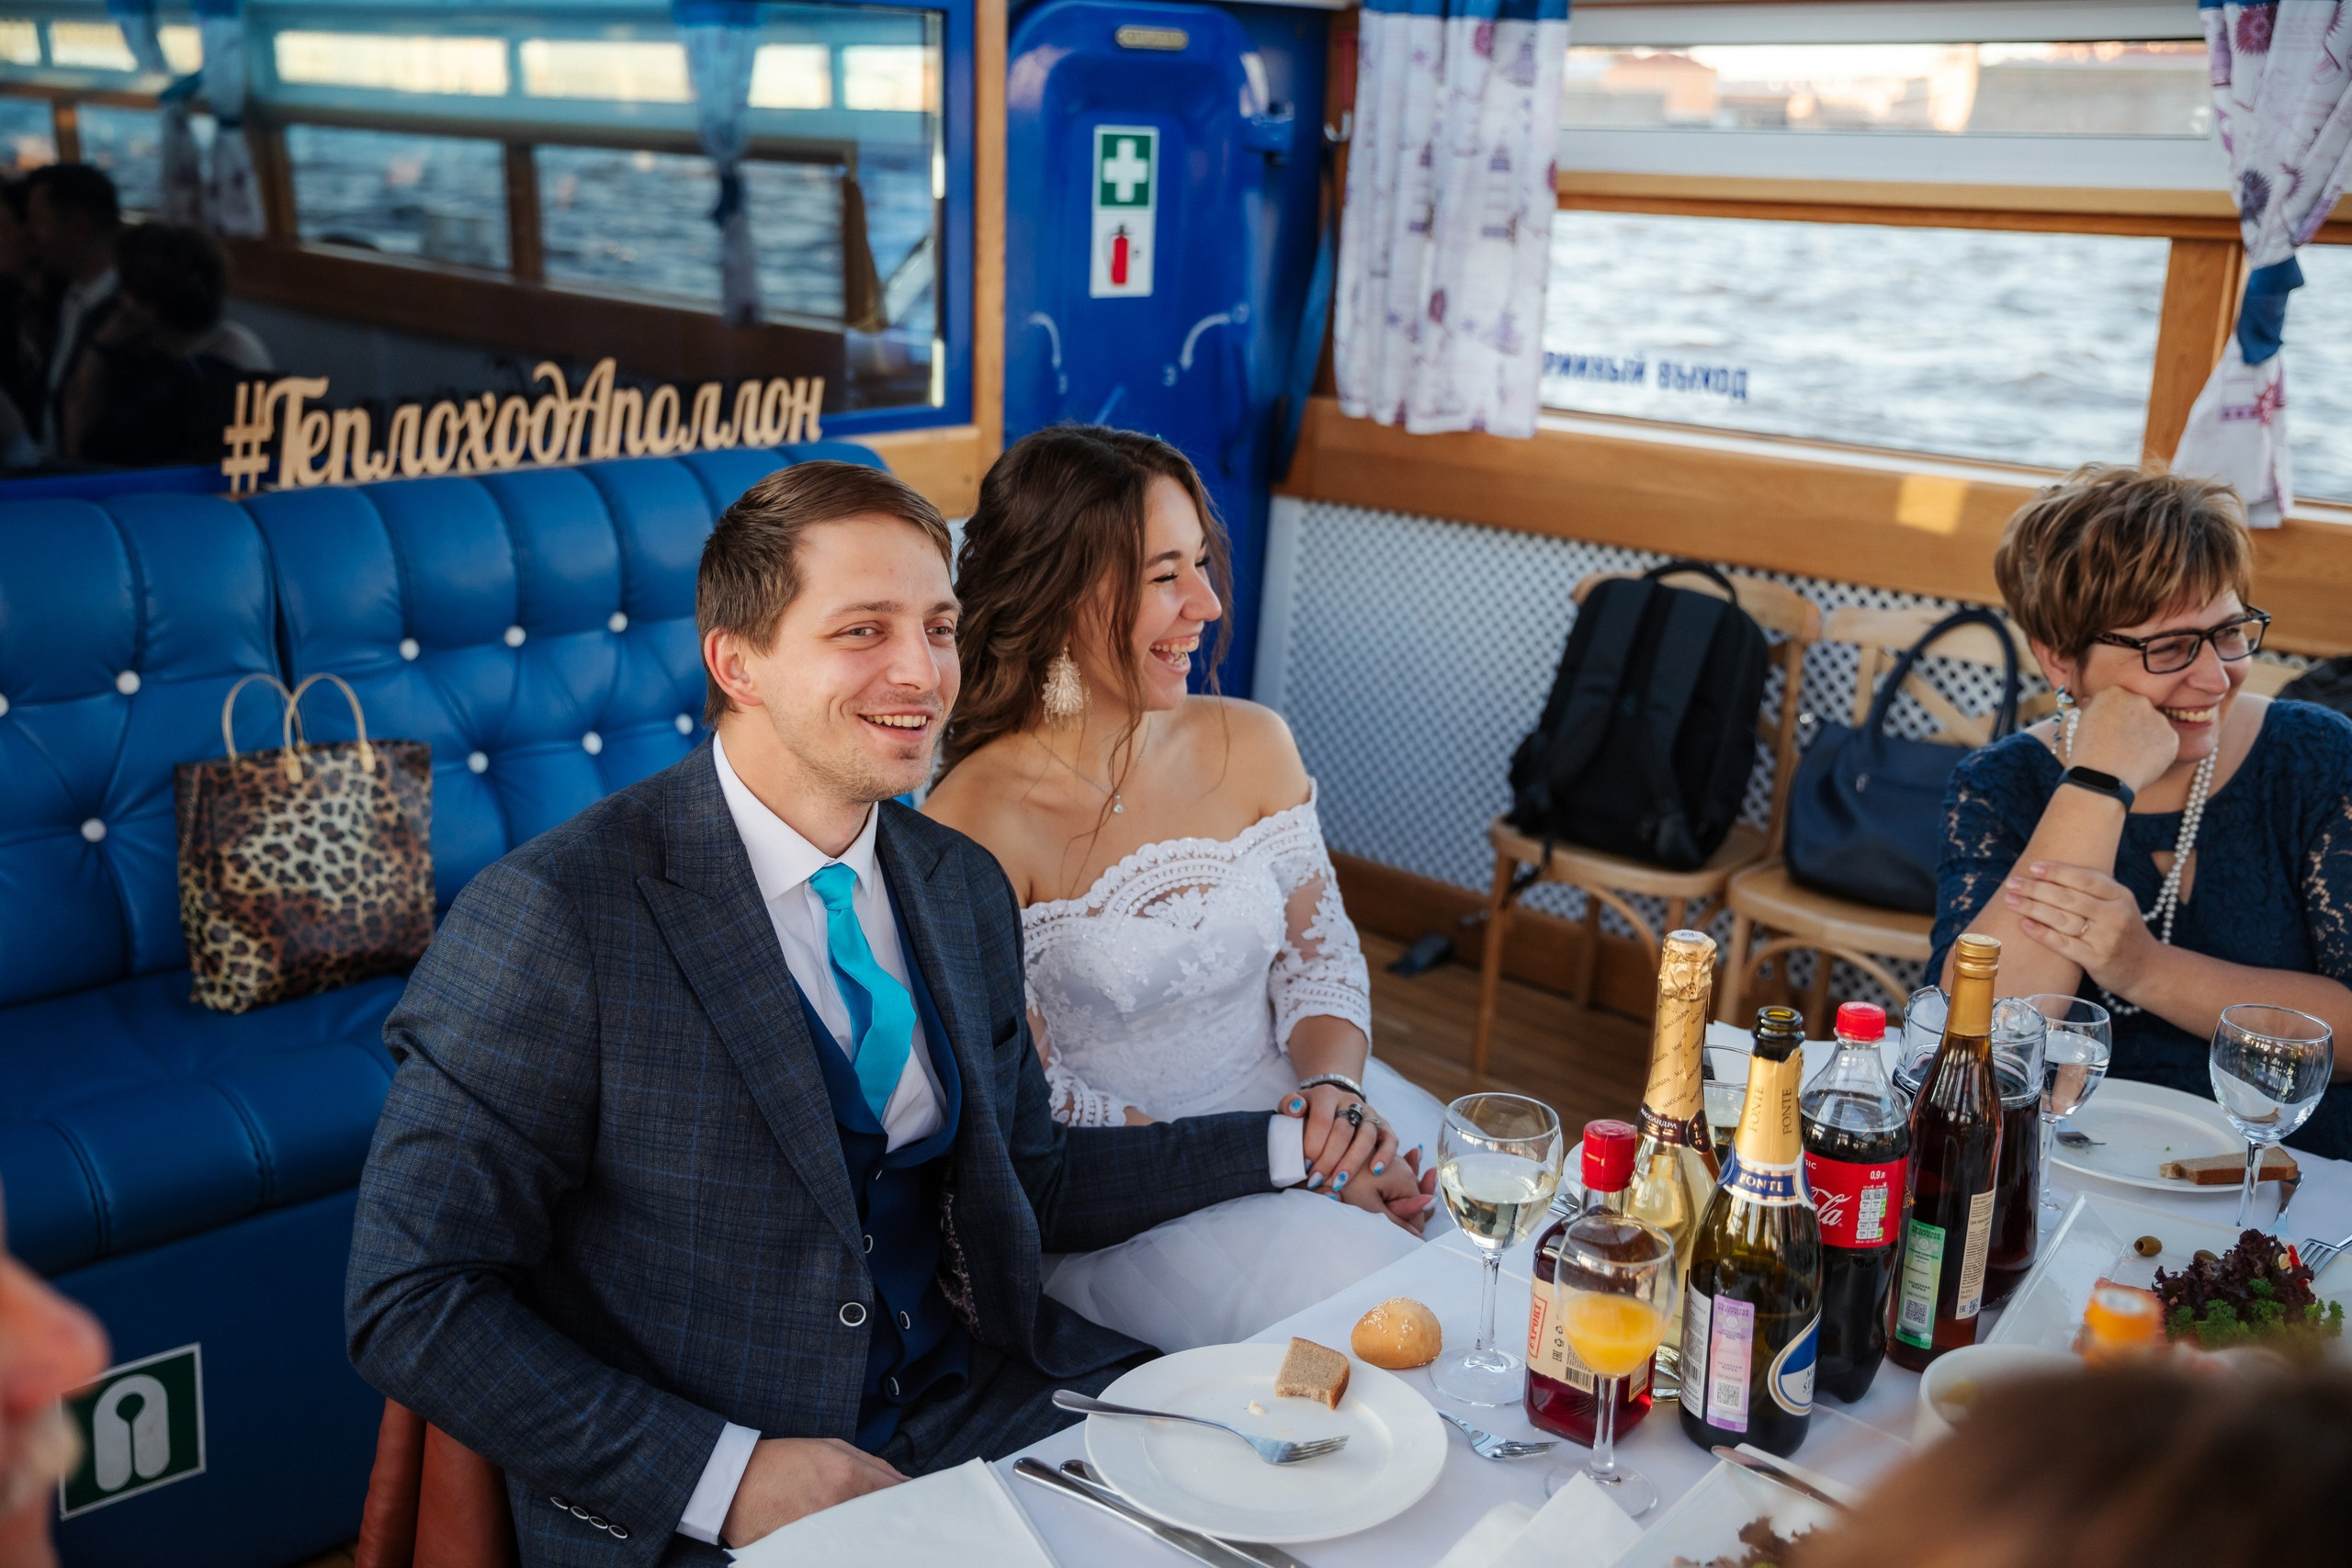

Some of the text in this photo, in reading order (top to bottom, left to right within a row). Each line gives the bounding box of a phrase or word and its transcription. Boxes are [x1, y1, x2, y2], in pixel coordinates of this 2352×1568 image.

[1658, 359, 1747, 401] ВЫХОД
[221, 357, 825, 494] #ТеплоходАполлон
[1640, 1107, 1677, 1130] МАССАНДРА
[1748, 1087, 1764, 1133] FONTE
[1782, 1088, 1792, 1135] FONTE
[1738, 1173, 1783, 1192] FONTE
[1530, 1302, 1542, 1350] EXPORT
